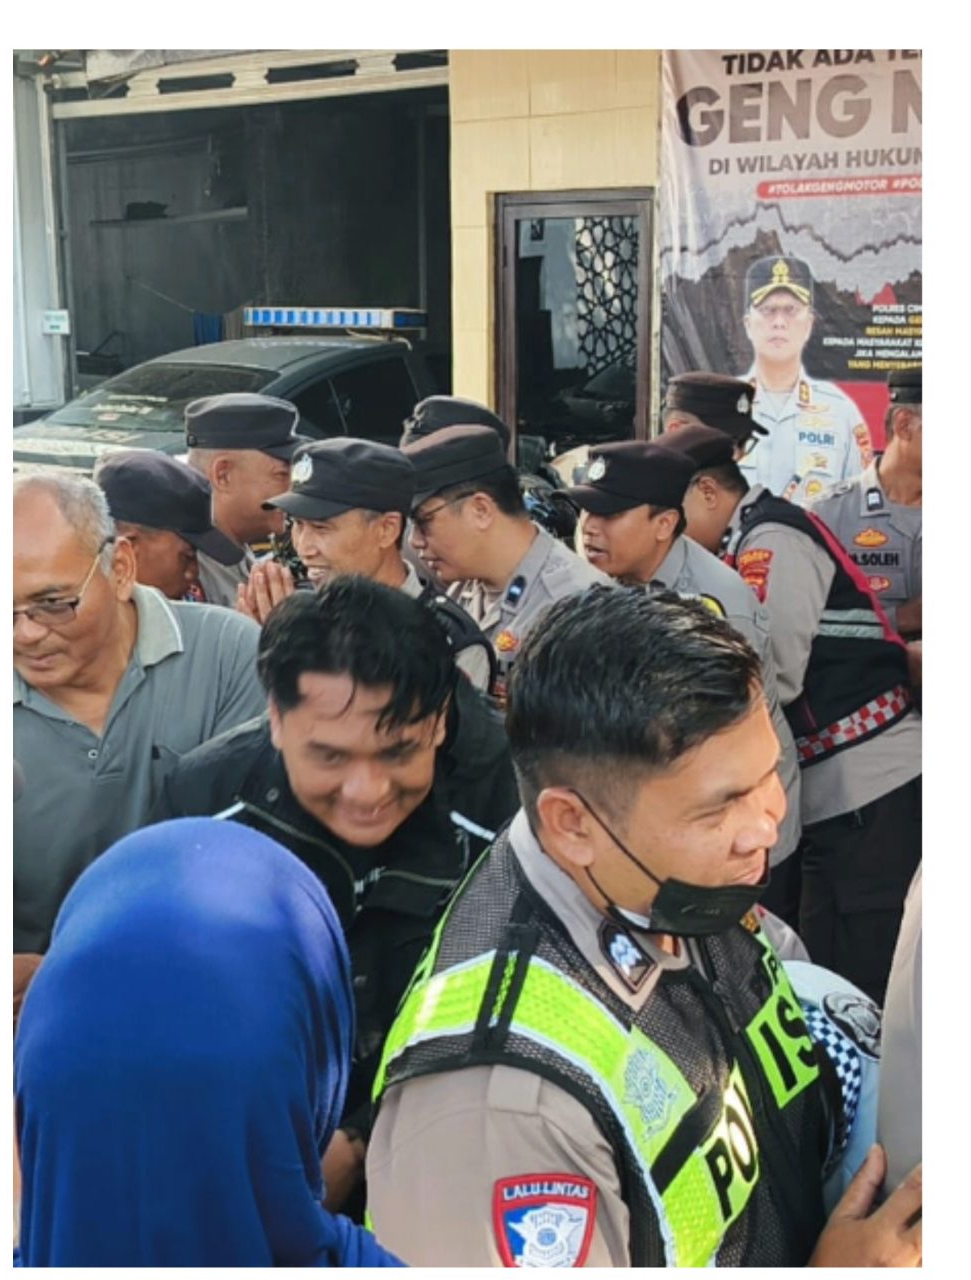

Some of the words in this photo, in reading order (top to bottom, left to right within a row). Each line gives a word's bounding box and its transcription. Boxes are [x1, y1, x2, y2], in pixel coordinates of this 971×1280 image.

[722, 51, 806, 76] TIDAK
[813, 48, 875, 67] ADA
[676, 74, 872, 147] GENG
[709, 157, 730, 175] DI
[737, 151, 839, 172] WILAYAH
[798, 431, 835, 446] POLRI
[503, 1184, 541, 1201] LALU
[545, 1182, 589, 1198] LINTAS
